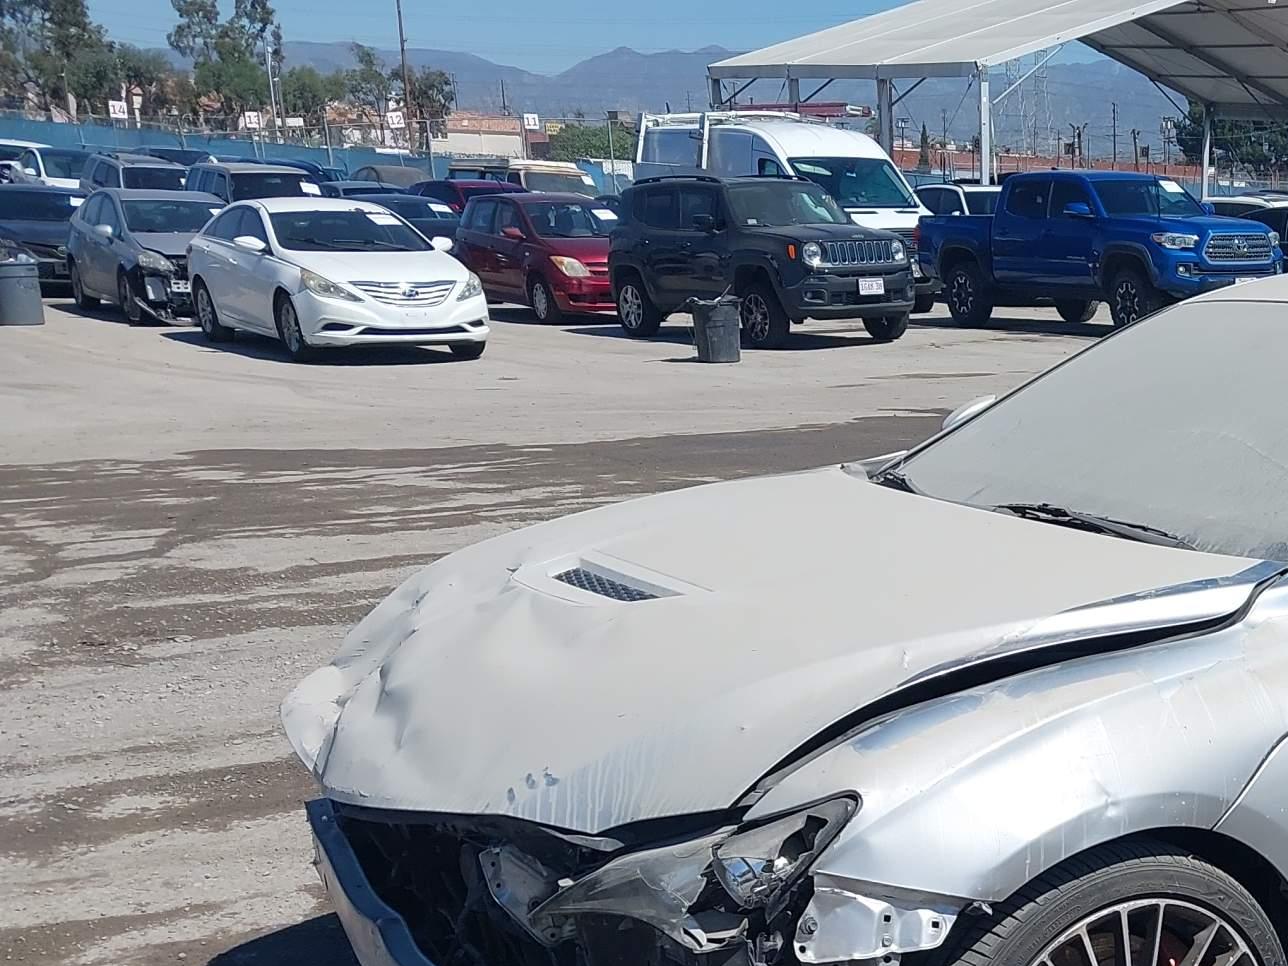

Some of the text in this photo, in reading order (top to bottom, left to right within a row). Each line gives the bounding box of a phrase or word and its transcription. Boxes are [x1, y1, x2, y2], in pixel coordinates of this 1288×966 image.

[111, 104, 126, 115] 14
[389, 115, 403, 125] 12
[525, 116, 537, 126] 11
